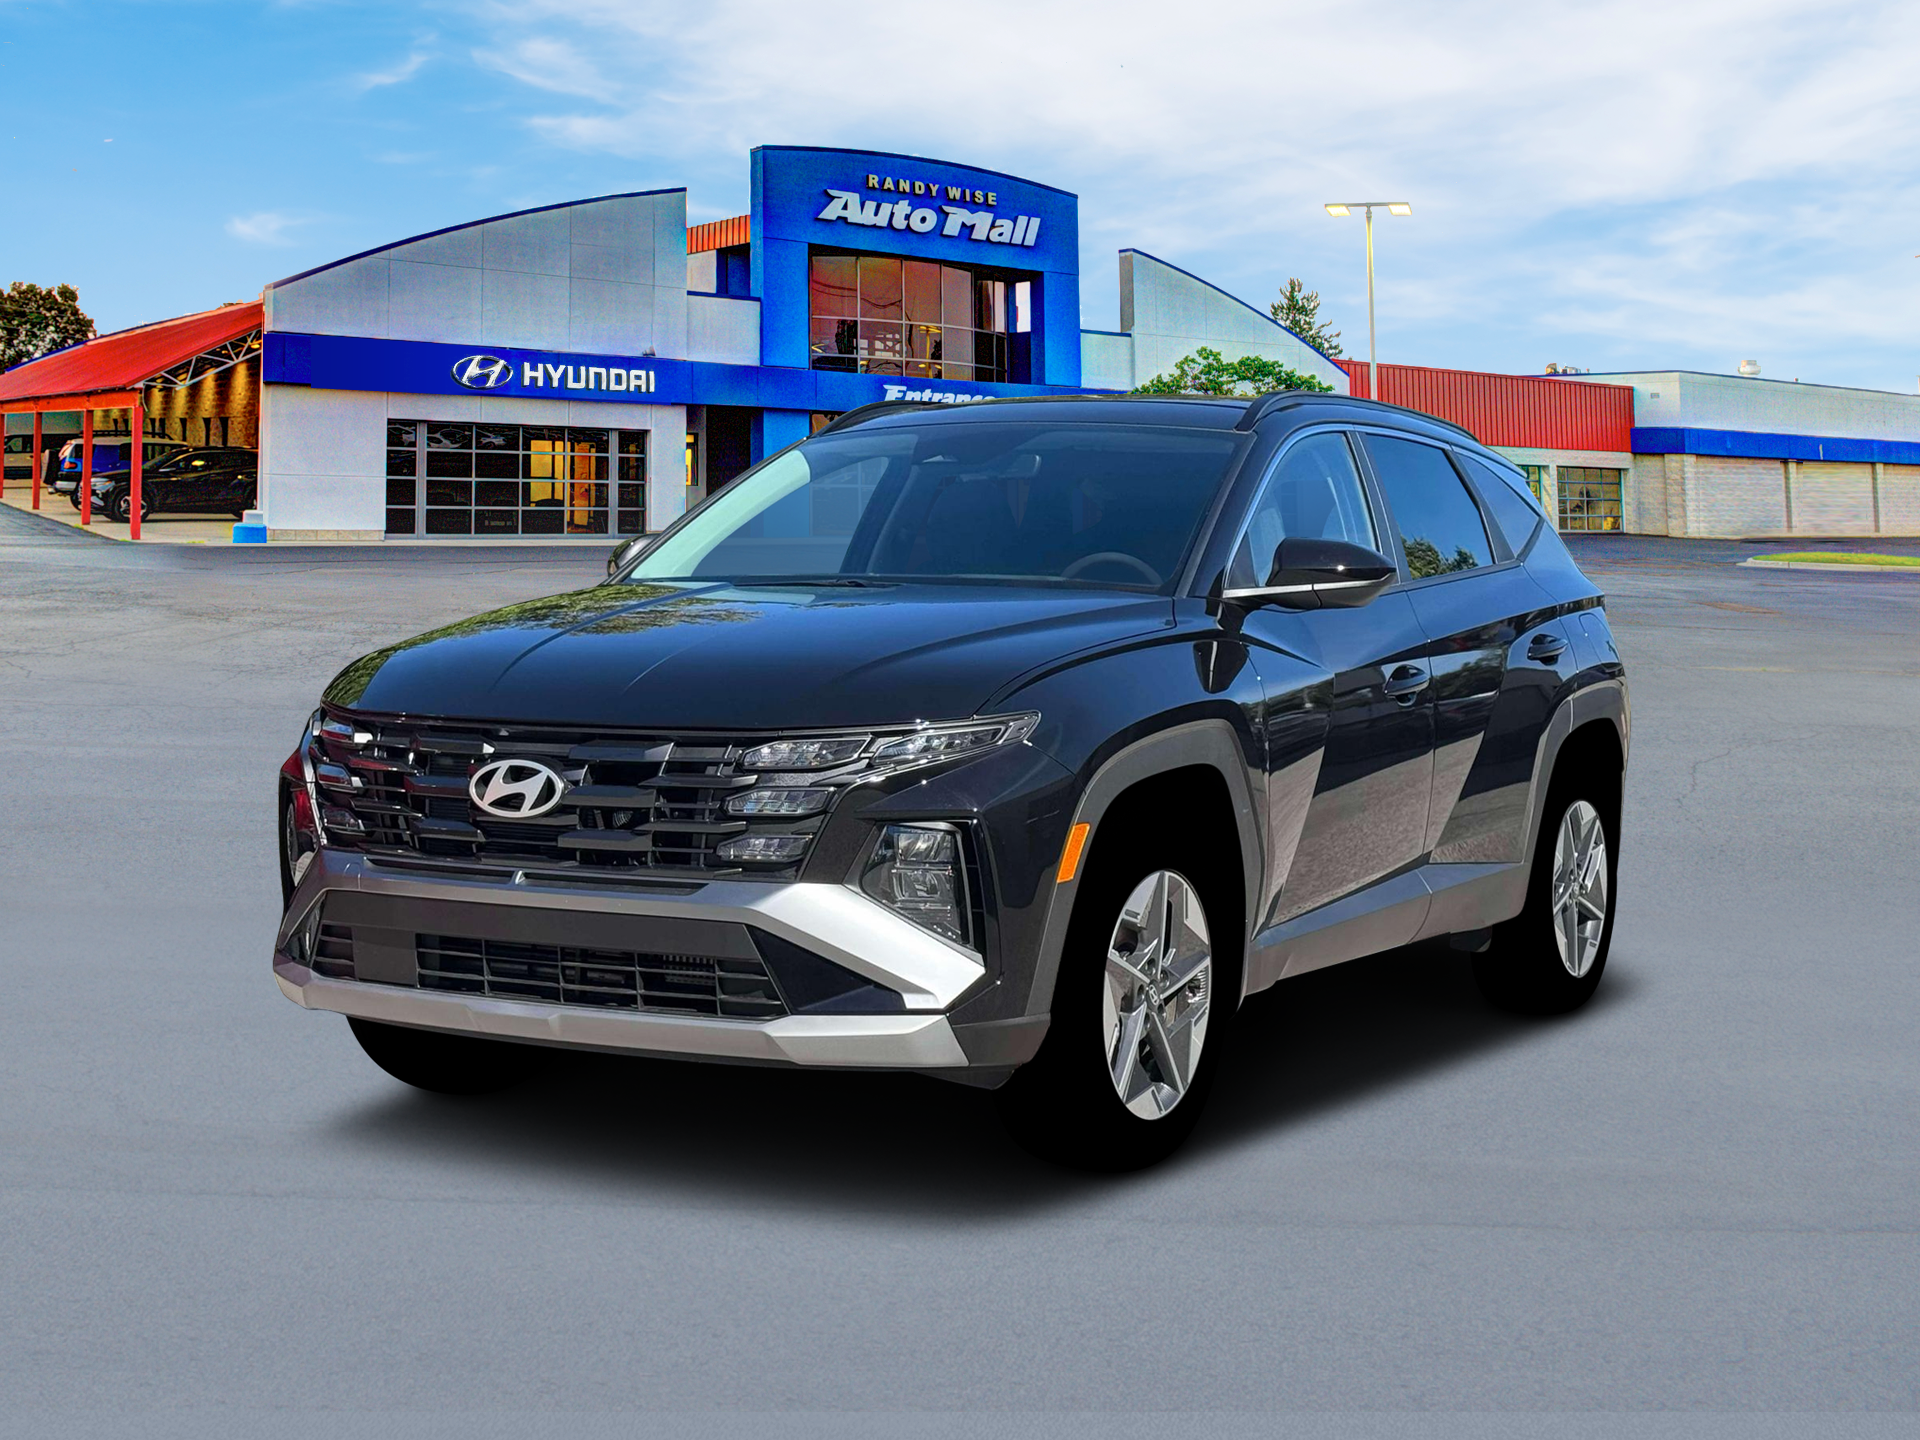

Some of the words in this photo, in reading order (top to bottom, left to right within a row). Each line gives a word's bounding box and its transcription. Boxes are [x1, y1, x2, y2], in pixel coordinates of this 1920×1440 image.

[867, 174, 940, 197] RANDY
[946, 186, 998, 206] WISE
[817, 188, 938, 233] Auto
[941, 204, 1041, 247] Mall
[523, 361, 655, 393] HYUNDAI
[882, 384, 996, 404] Entran
